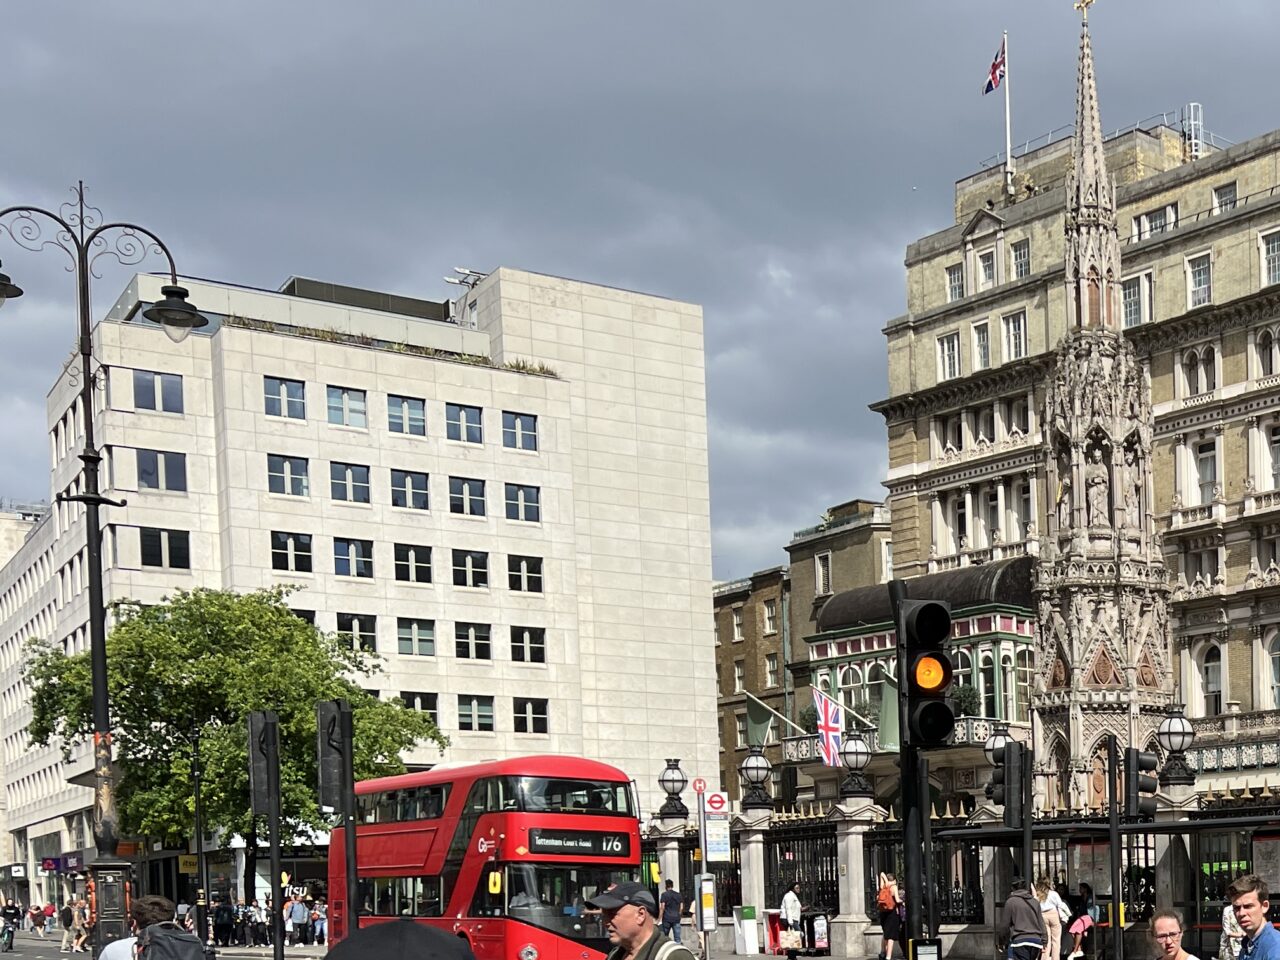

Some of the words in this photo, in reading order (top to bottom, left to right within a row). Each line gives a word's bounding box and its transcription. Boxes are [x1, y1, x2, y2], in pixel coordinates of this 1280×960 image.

[695, 780, 704, 790] H
[535, 836, 562, 846] Tottenham
[563, 837, 578, 847] Court
[579, 838, 592, 848] Road
[602, 836, 622, 852] 176
[284, 885, 308, 897] itsu
